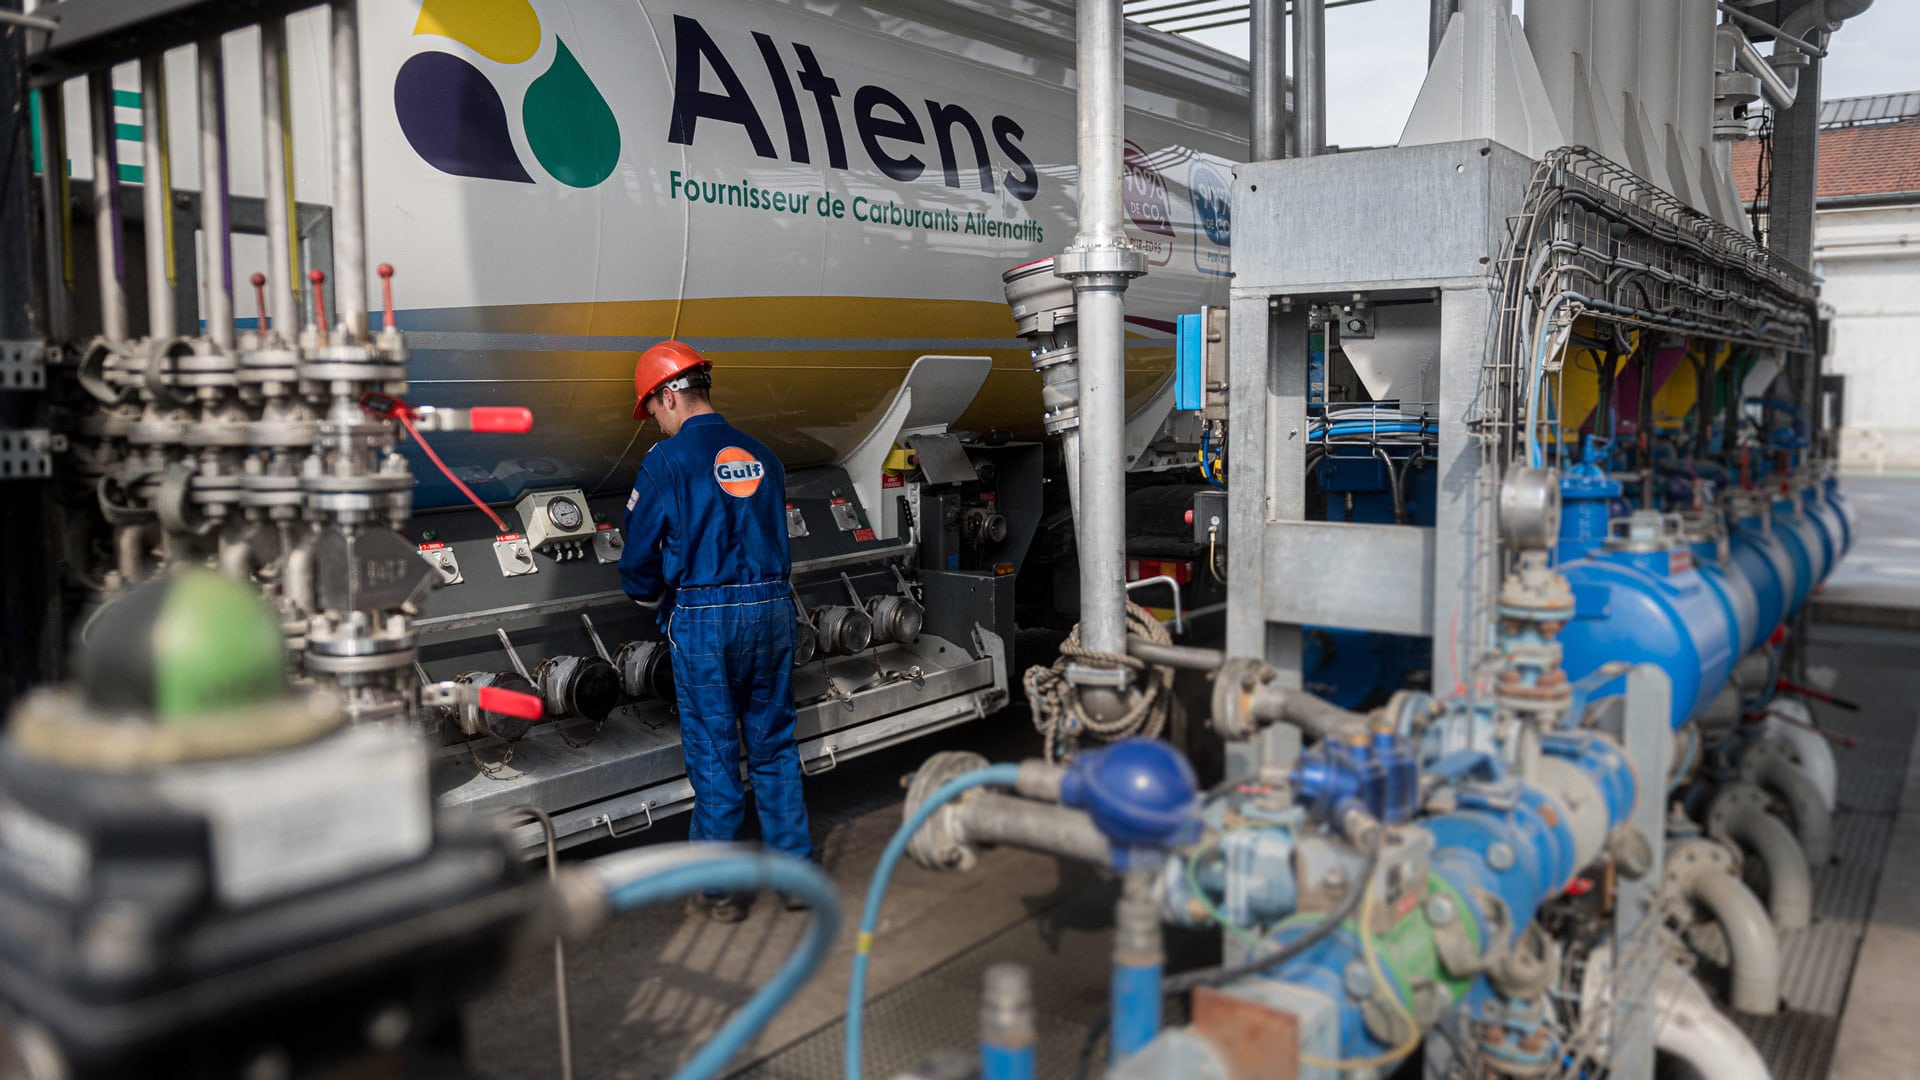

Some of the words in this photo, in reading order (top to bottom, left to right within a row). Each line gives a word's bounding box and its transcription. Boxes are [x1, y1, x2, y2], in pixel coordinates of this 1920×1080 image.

[668, 14, 1039, 201] Altens
[670, 170, 809, 215] Fournisseur
[817, 191, 845, 219] de
[852, 196, 959, 233] Carburants
[964, 211, 1044, 243] Alternatifs
[1130, 201, 1141, 215] DE
[717, 463, 761, 480] Gulf
